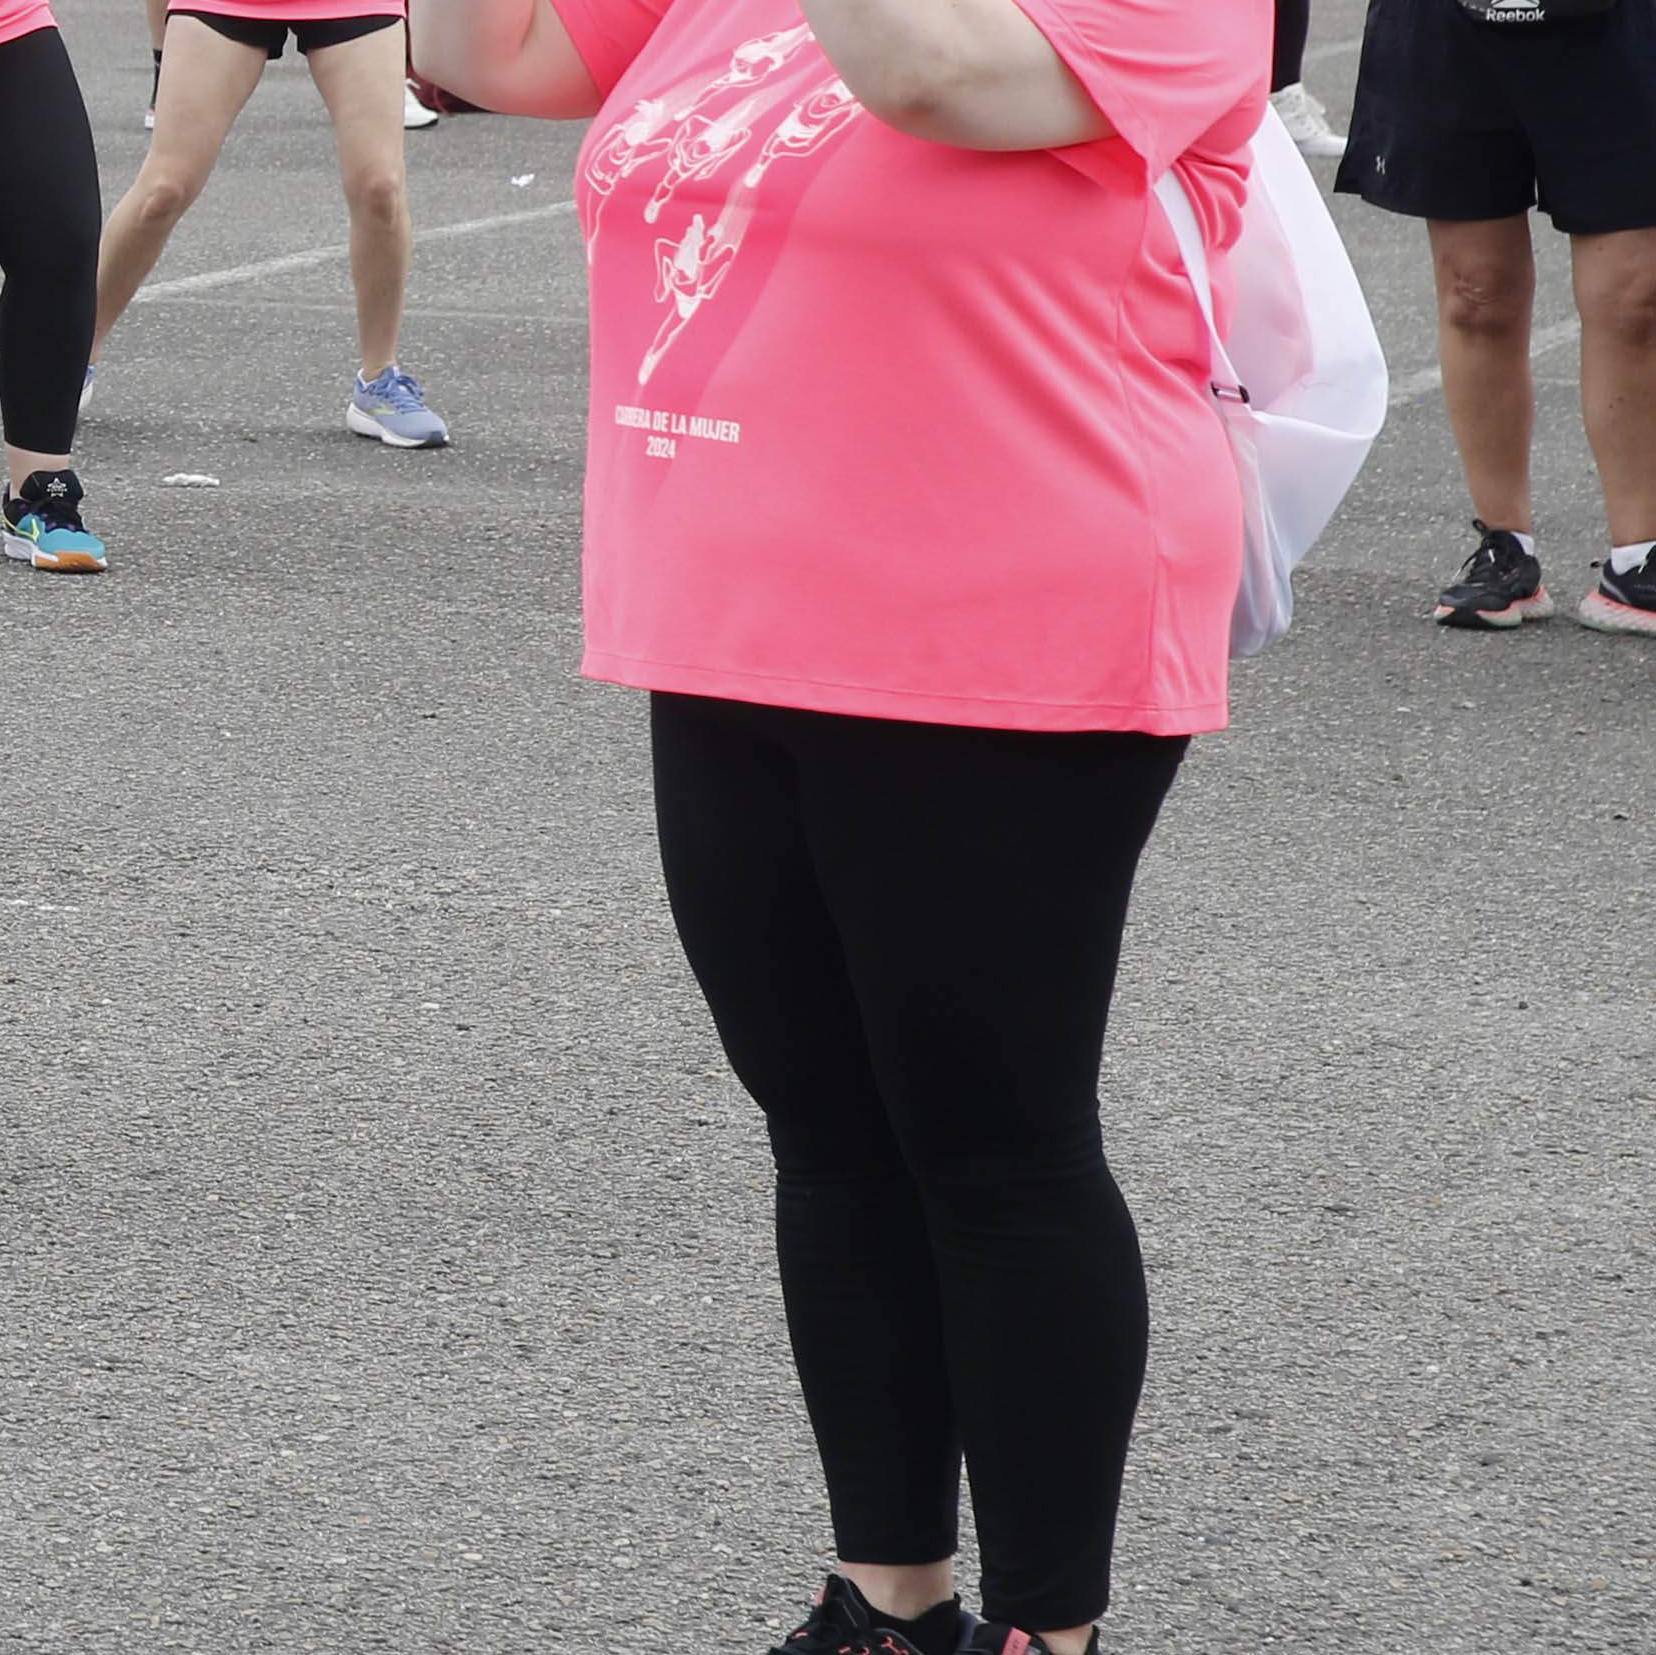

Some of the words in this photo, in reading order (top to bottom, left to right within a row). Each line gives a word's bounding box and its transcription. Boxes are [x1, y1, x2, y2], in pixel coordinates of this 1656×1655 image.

[1486, 8, 1546, 22] Reebok
[653, 410, 669, 433] DE
[671, 413, 687, 435] LA
[689, 416, 740, 444] MUJER
[645, 435, 677, 459] 2024
